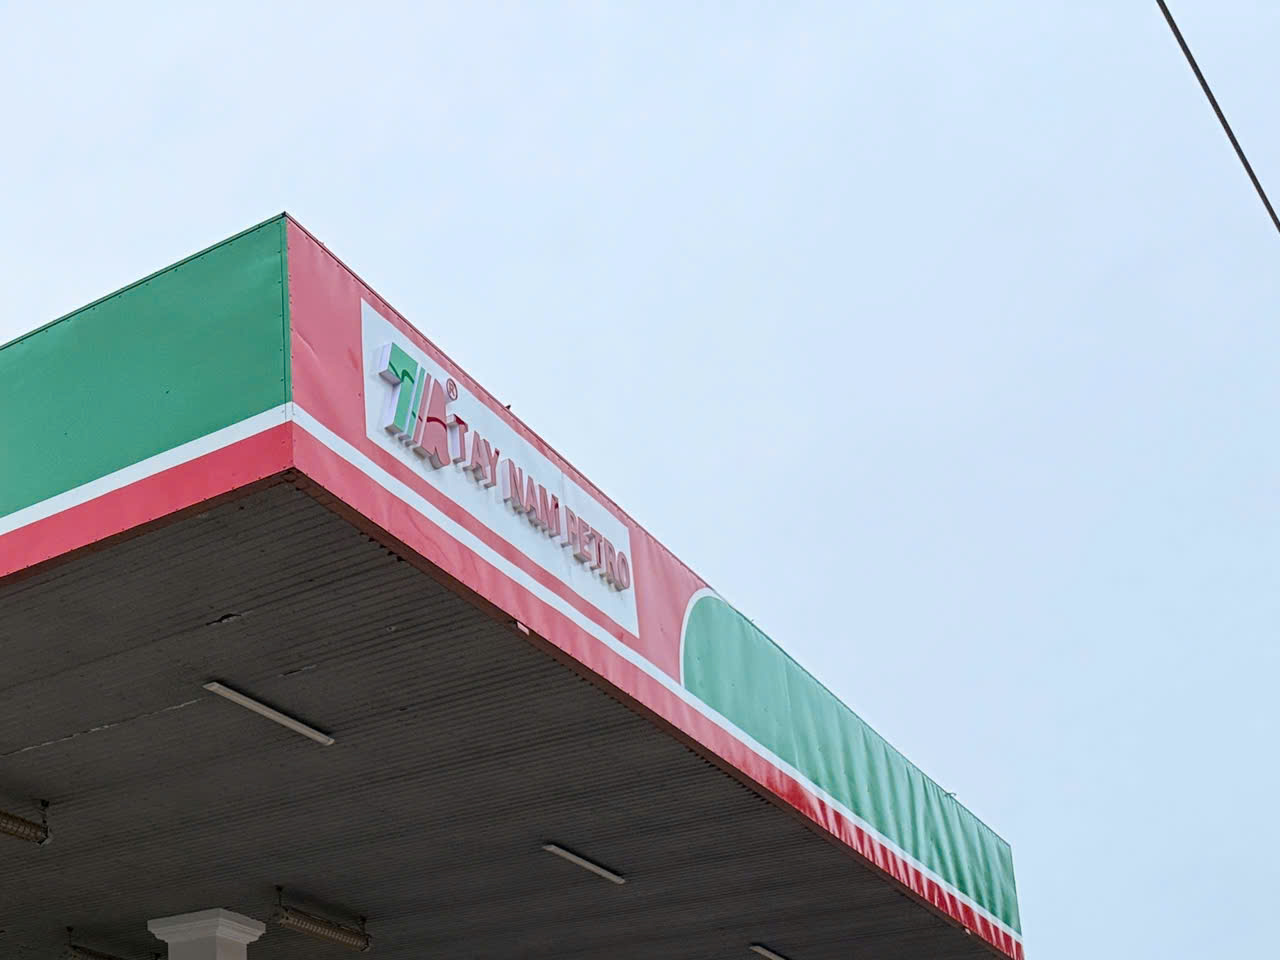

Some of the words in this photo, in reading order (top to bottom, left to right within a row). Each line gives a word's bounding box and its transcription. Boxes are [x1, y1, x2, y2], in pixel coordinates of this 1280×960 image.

[447, 414, 500, 488] TAY
[502, 459, 560, 538] NAM
[561, 506, 631, 592] PETRO
